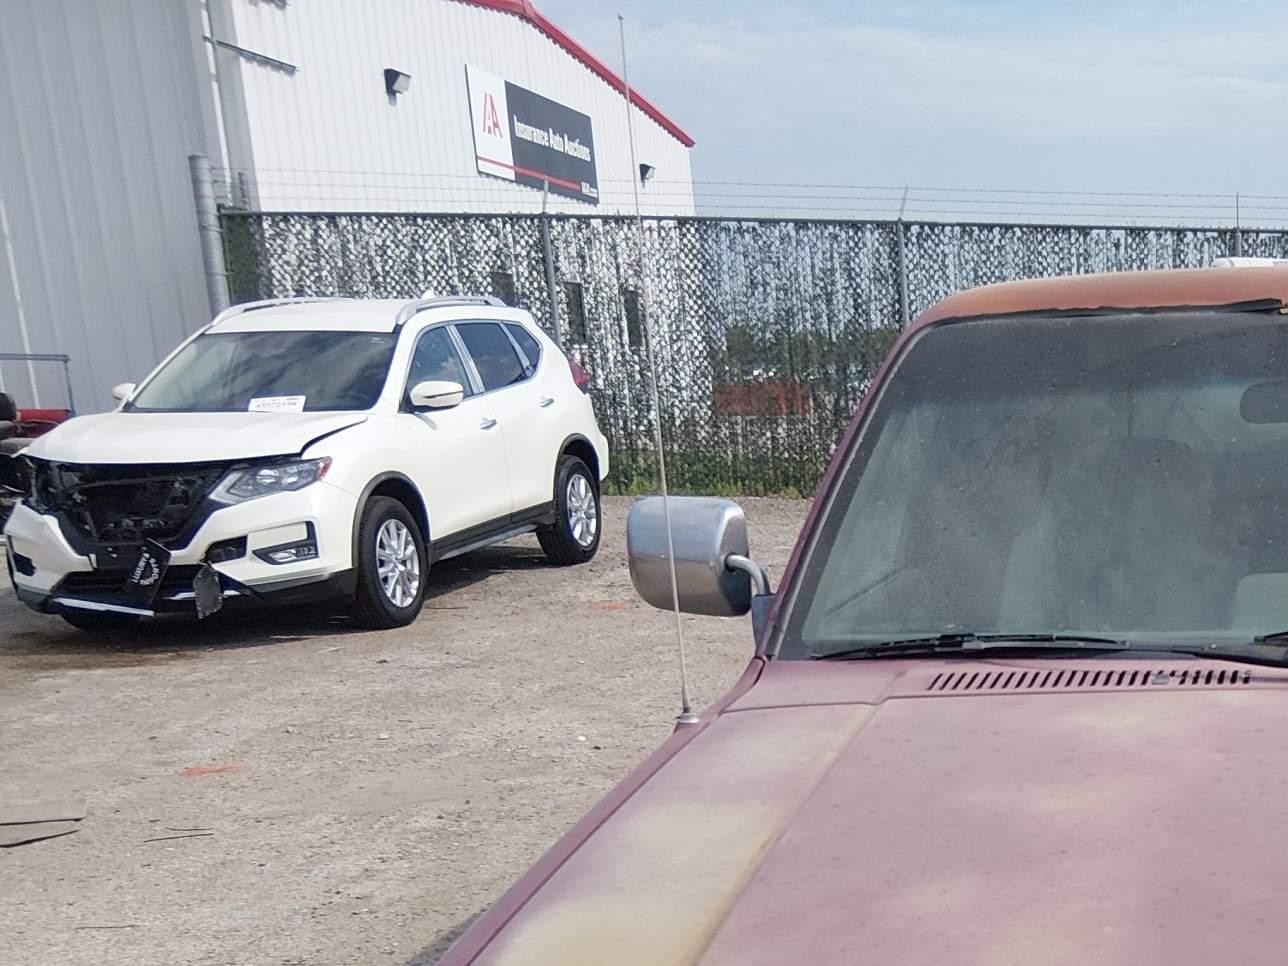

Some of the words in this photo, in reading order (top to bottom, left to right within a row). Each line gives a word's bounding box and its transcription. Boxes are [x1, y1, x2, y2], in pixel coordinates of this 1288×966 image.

[513, 114, 549, 147] Insurance
[549, 127, 564, 152] Auto
[564, 133, 591, 162] Auctions
